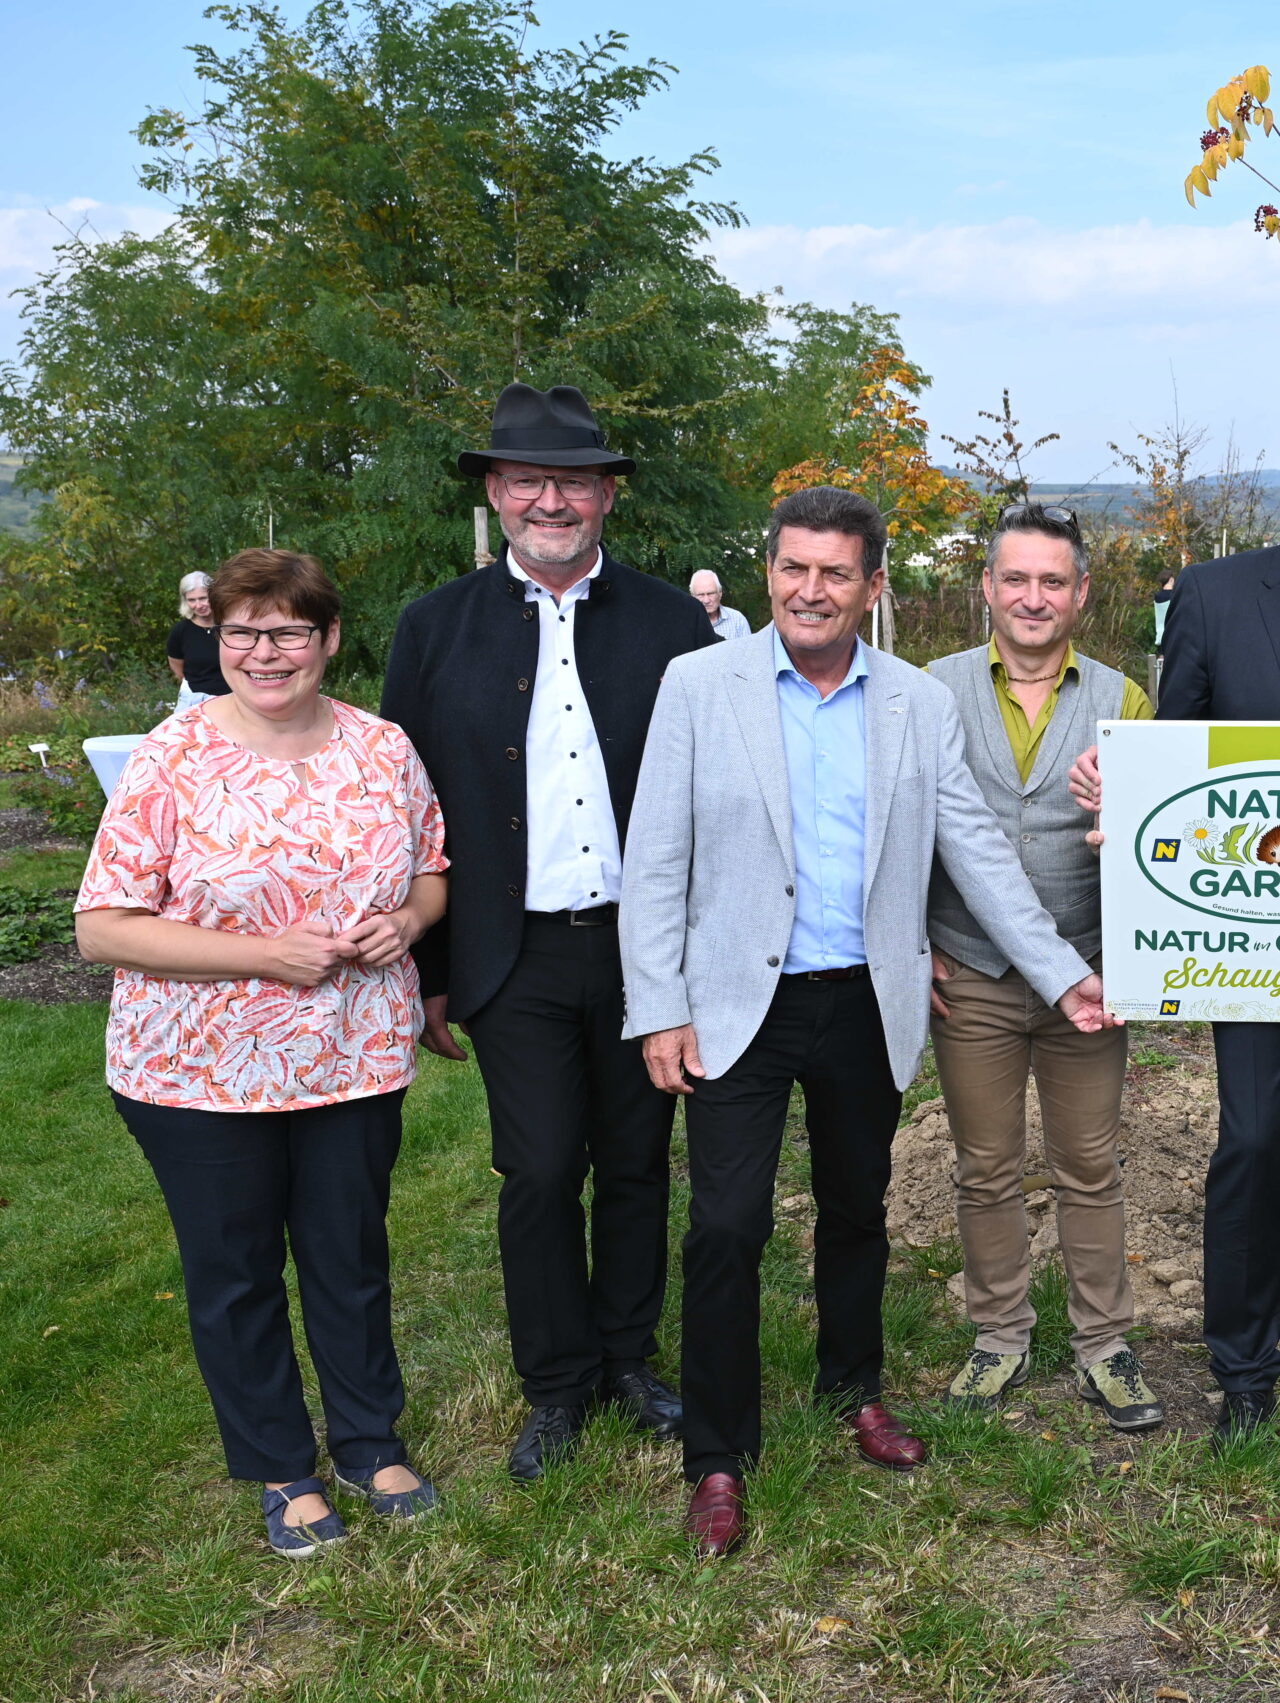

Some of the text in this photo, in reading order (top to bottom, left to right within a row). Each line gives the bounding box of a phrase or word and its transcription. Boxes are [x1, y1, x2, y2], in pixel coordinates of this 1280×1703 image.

[1155, 842, 1176, 859] N
[1212, 903, 1239, 914] Gesund
[1240, 908, 1265, 917] halten,
[1135, 930, 1249, 952] NATUR
[1253, 940, 1271, 952] im
[1162, 1001, 1178, 1013] N
